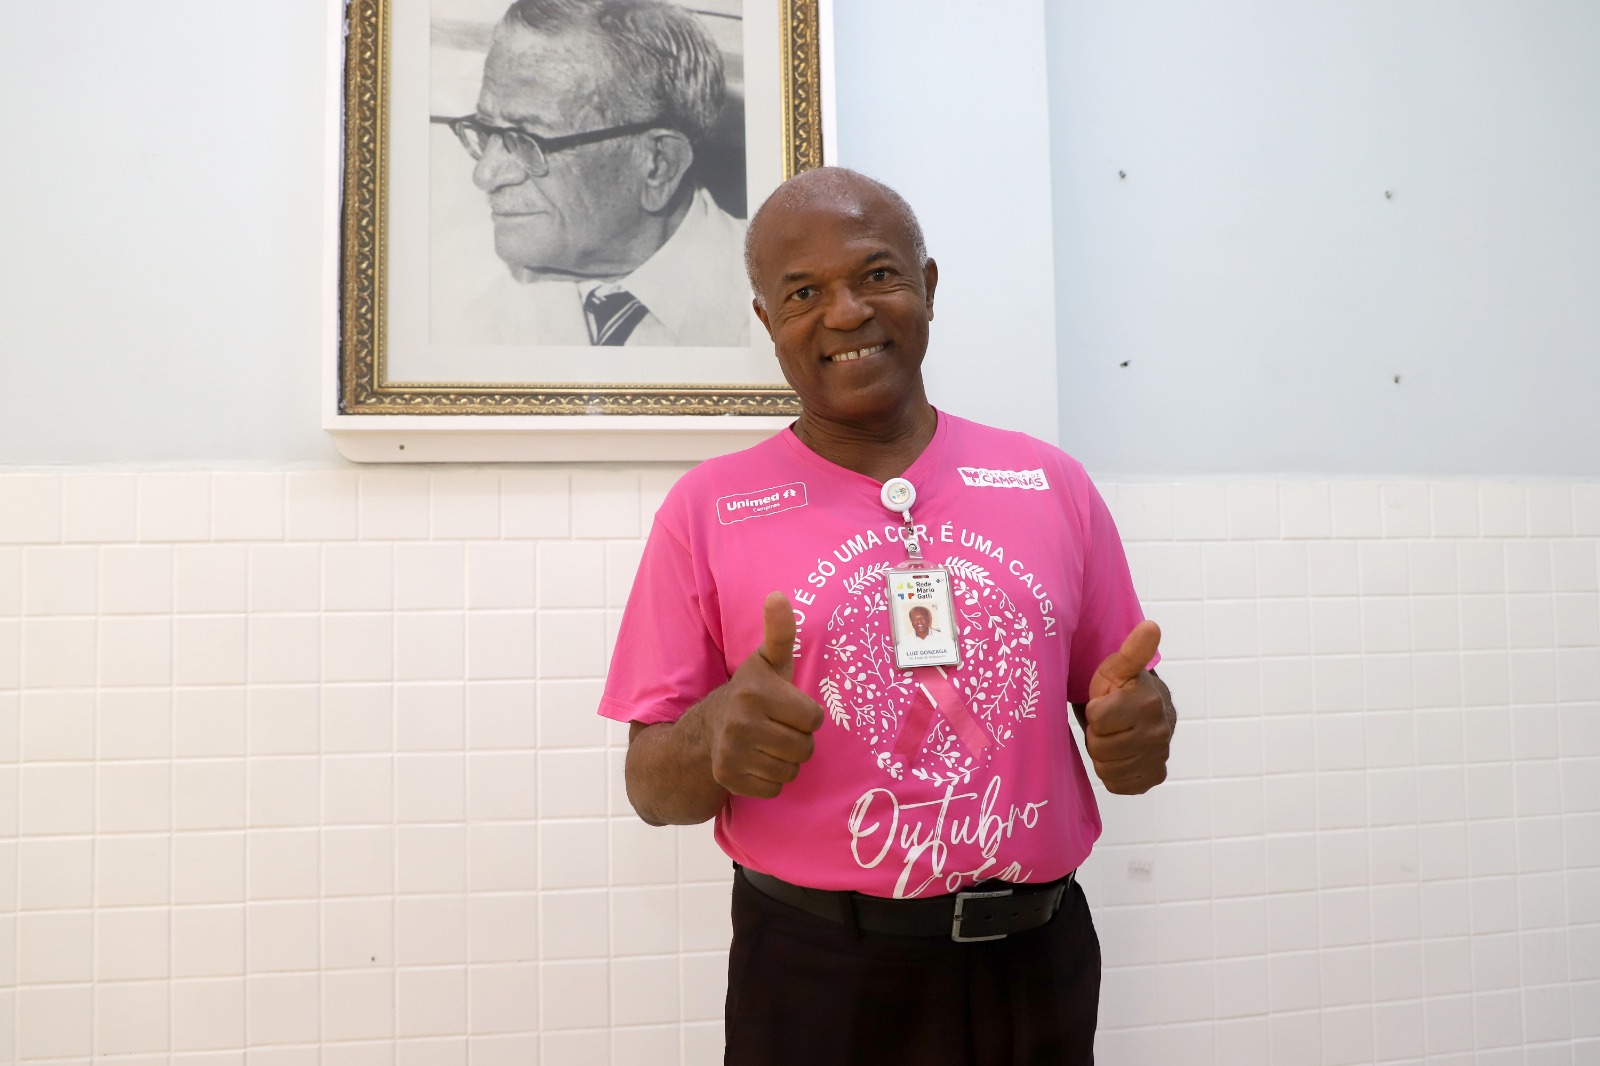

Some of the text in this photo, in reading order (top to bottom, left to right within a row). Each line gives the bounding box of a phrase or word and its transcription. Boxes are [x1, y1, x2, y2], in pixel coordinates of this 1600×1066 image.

[726, 493, 779, 511] Unimed
[794, 588, 816, 606] É
[807, 558, 836, 588] SÓ
[833, 530, 882, 563] UMA
[884, 524, 934, 545] COR,
[940, 521, 954, 543] É
[960, 529, 1004, 564] UMA
[1009, 560, 1057, 637] CAUSA!
[848, 775, 1048, 869] Outubro
